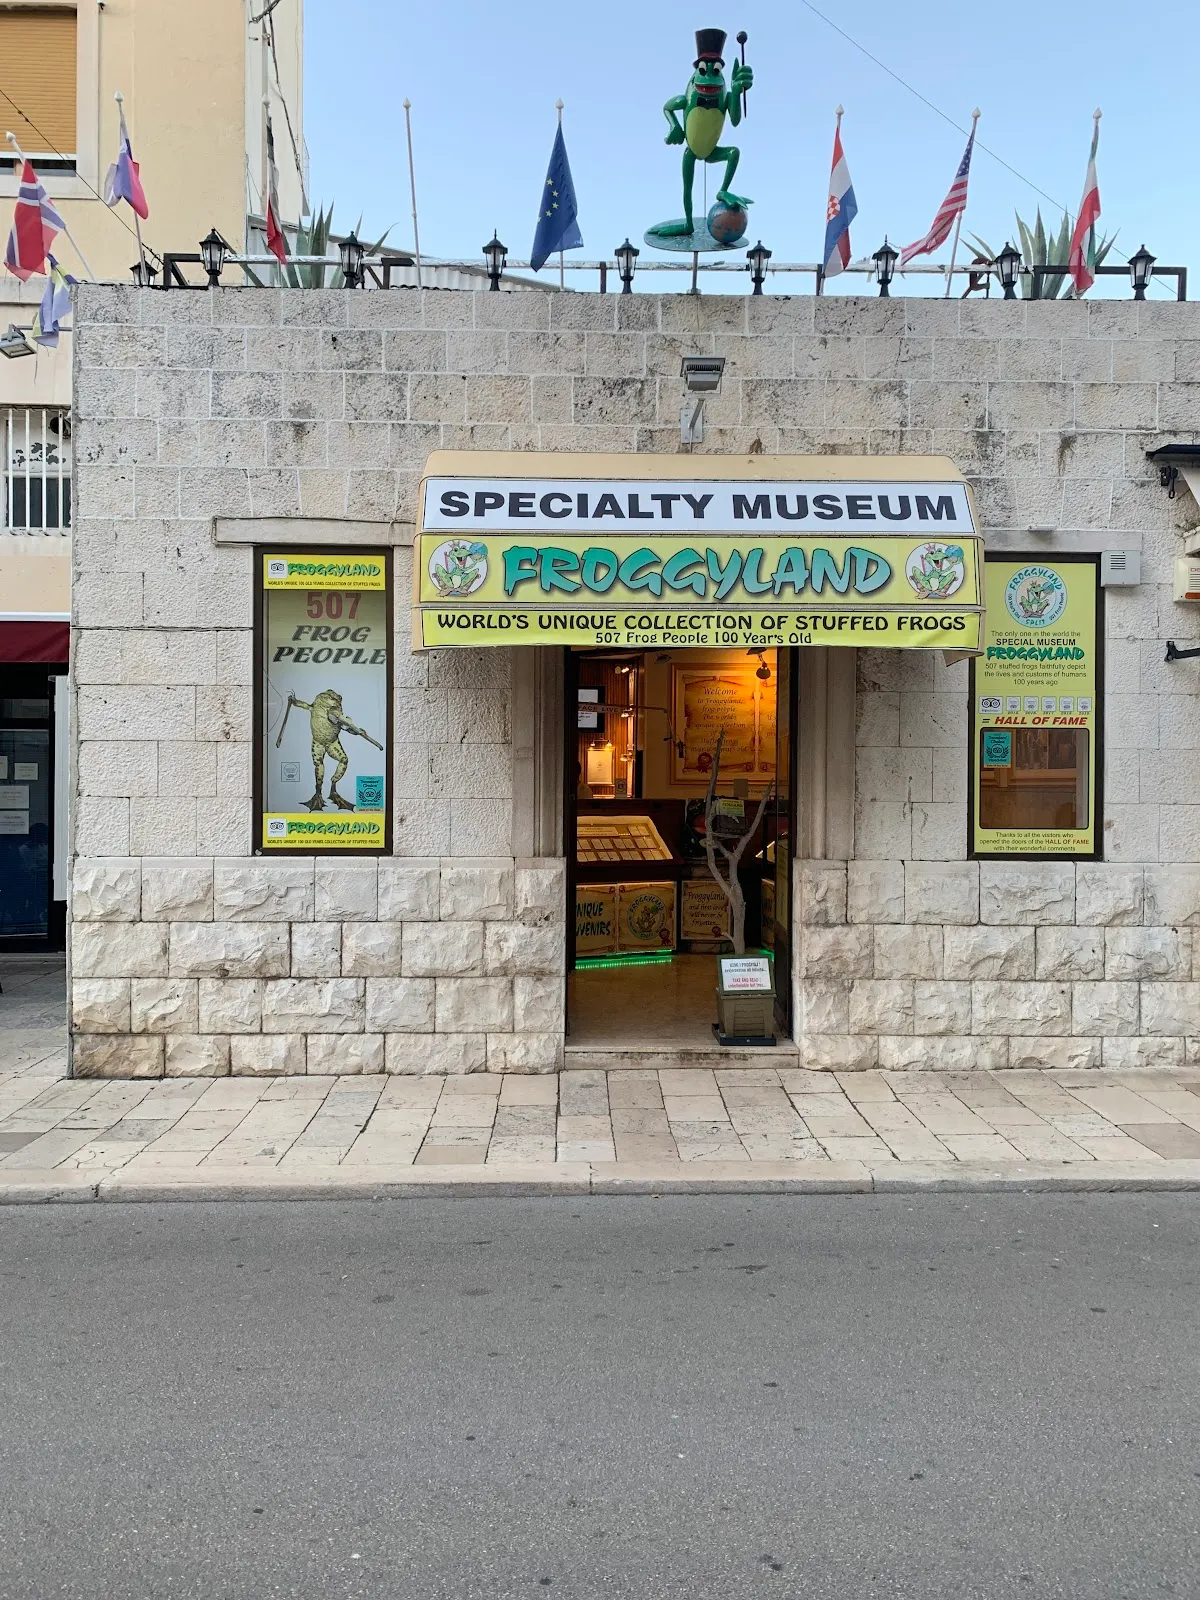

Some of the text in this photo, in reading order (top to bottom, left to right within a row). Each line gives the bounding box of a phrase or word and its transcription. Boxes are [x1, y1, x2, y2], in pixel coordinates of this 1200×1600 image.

[439, 490, 957, 521] SPECIALTY MUSEUM
[288, 563, 380, 577] FROGGYLAND
[502, 545, 891, 601] FROGGYLAND
[1010, 568, 1063, 590] FROGGYLAND
[306, 592, 362, 619] 507
[438, 615, 966, 631] WORLD'S UNIQUE COLLECTION OF STUFFED FROGS
[292, 625, 372, 642] FROG
[596, 633, 812, 644] 507 Frog People 100 Year's Old
[273, 646, 386, 664] PEOPLE
[987, 647, 1084, 662] FROGGYLAND
[704, 687, 738, 695] Welcome
[287, 822, 380, 835] FROGGYLAND
[686, 891, 725, 903] Froggyland
[576, 902, 603, 919] NIQUE
